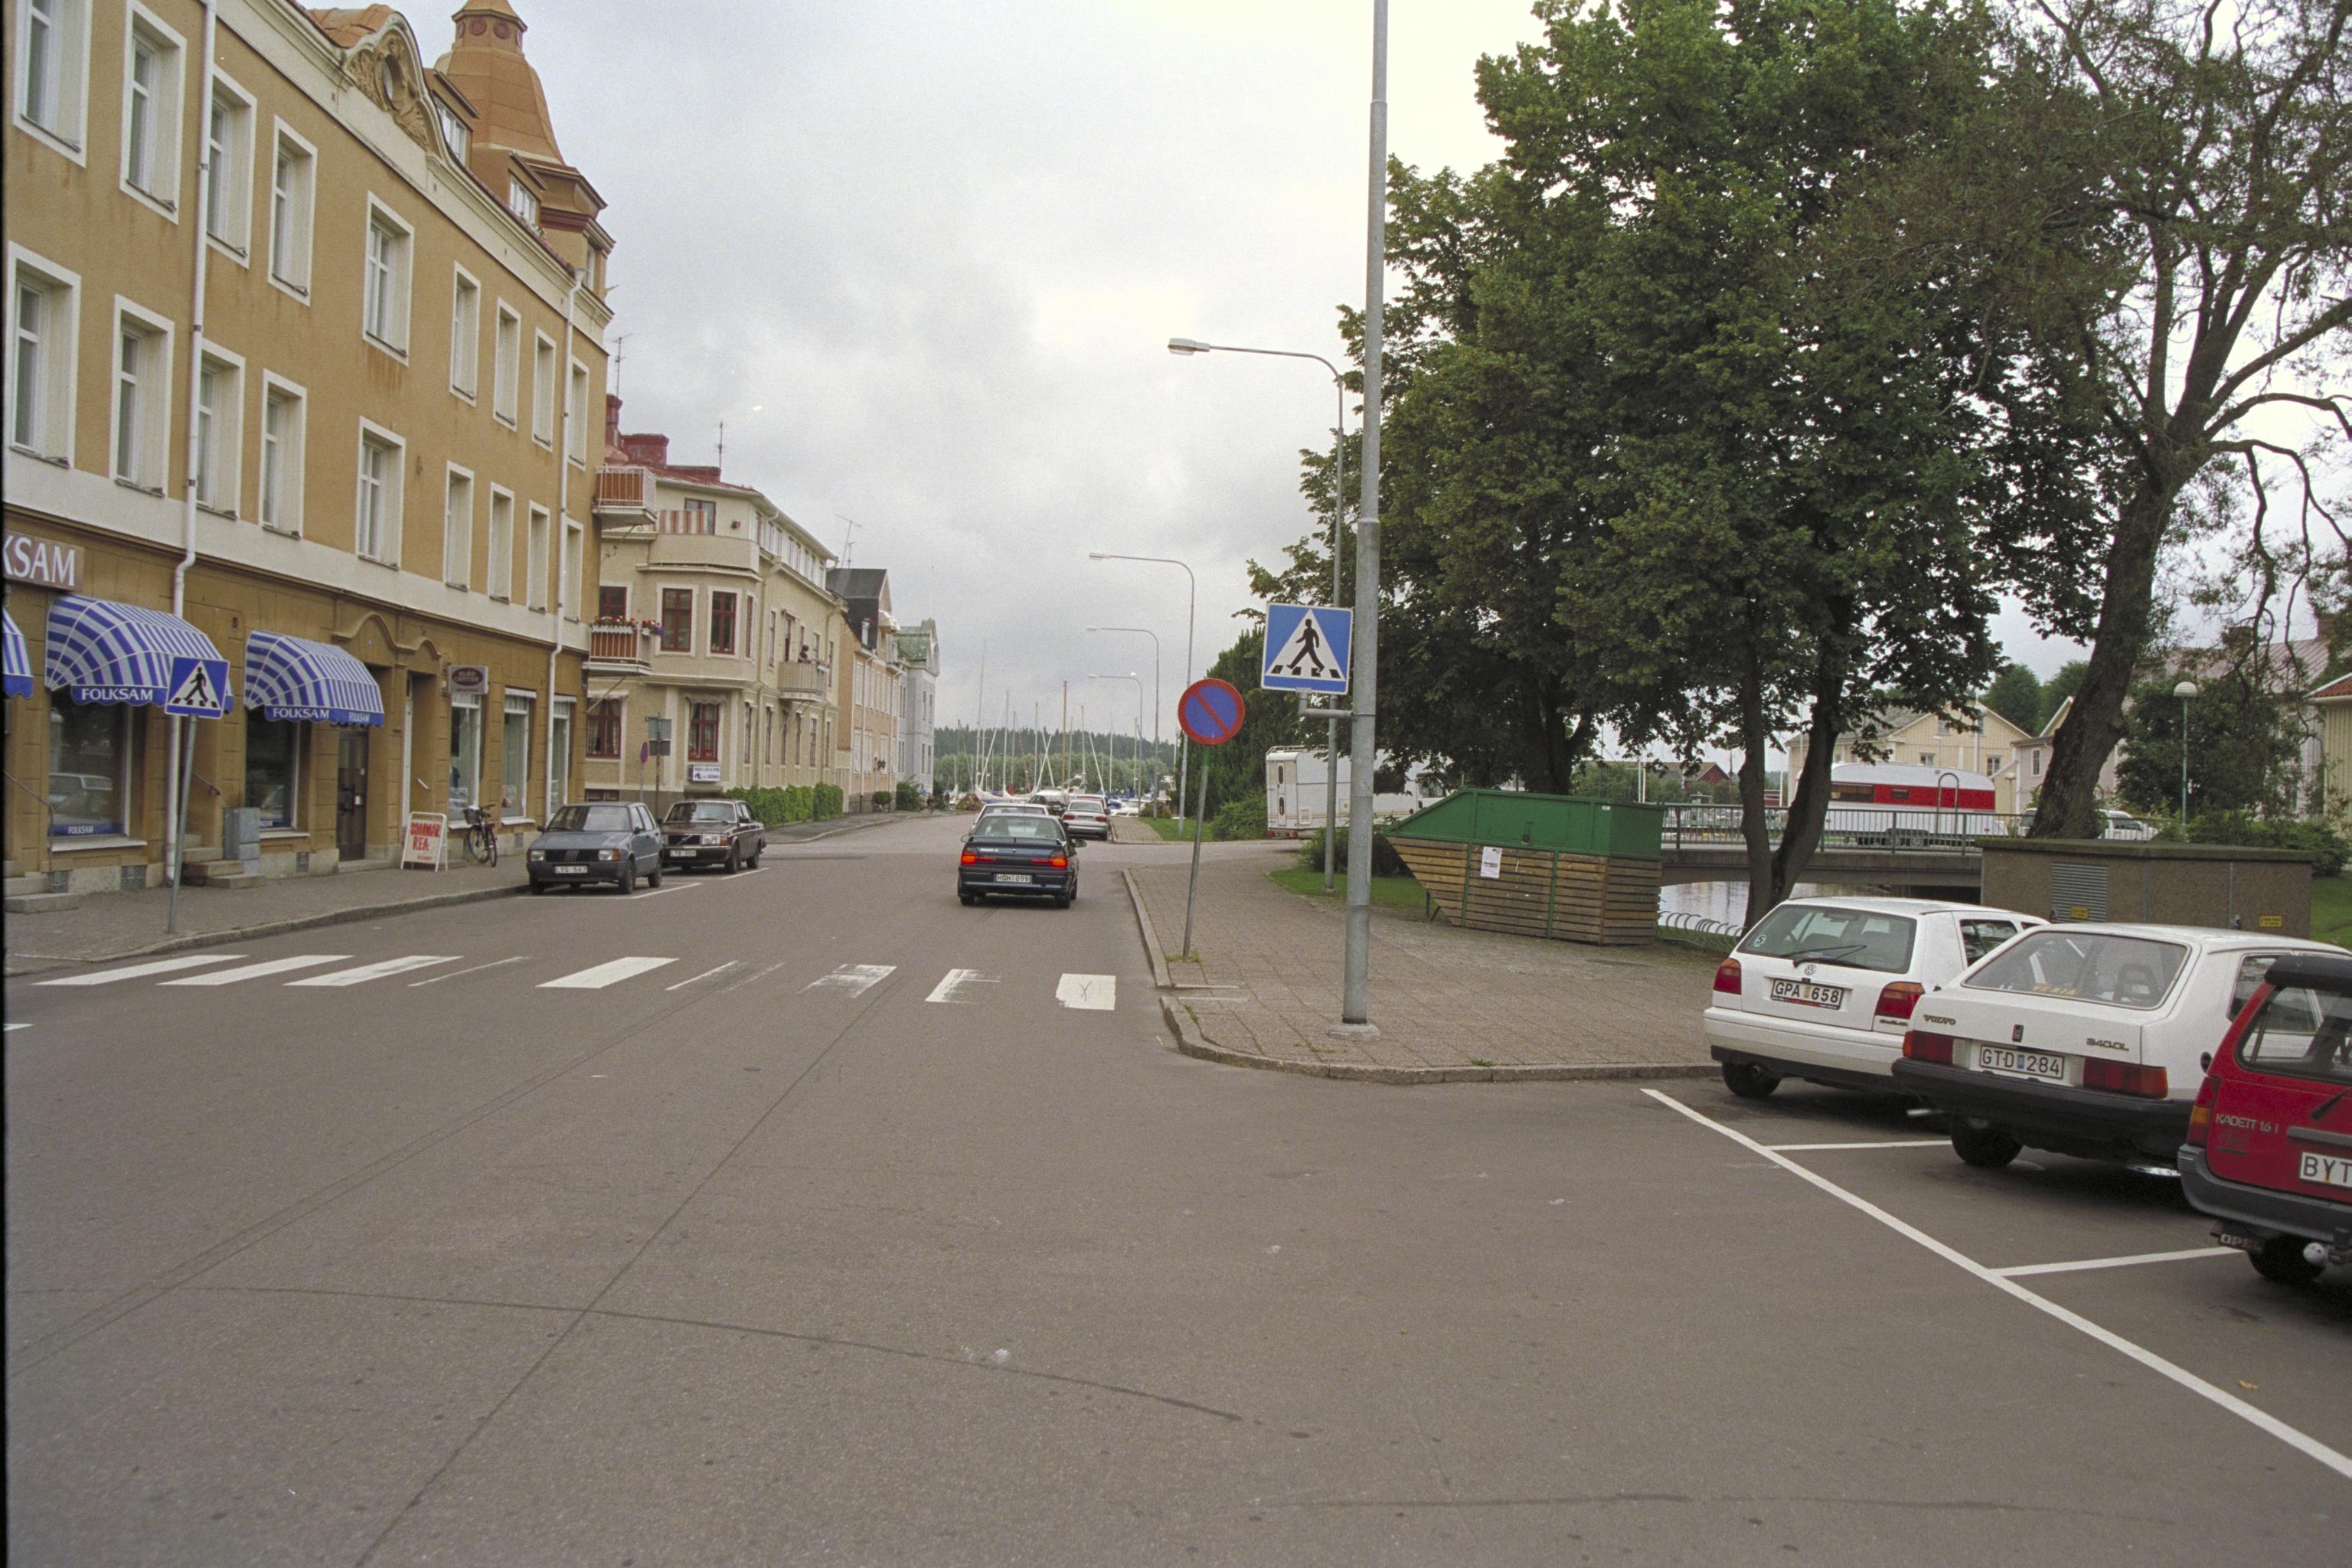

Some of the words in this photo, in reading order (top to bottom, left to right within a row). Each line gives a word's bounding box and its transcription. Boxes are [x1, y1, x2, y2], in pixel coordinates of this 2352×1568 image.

[81, 688, 153, 701] FOLKSAM
[273, 707, 330, 719] FOLKSAM
[413, 835, 430, 851] REA
[1775, 982, 1800, 998] GPA
[1811, 987, 1839, 1003] 658
[1923, 1014, 1956, 1026] VOLVO
[1982, 1049, 2014, 1067] GTD
[2027, 1055, 2060, 1075] 284
[2216, 1113, 2256, 1129] KADETT
[2303, 1155, 2352, 1184] BYT
